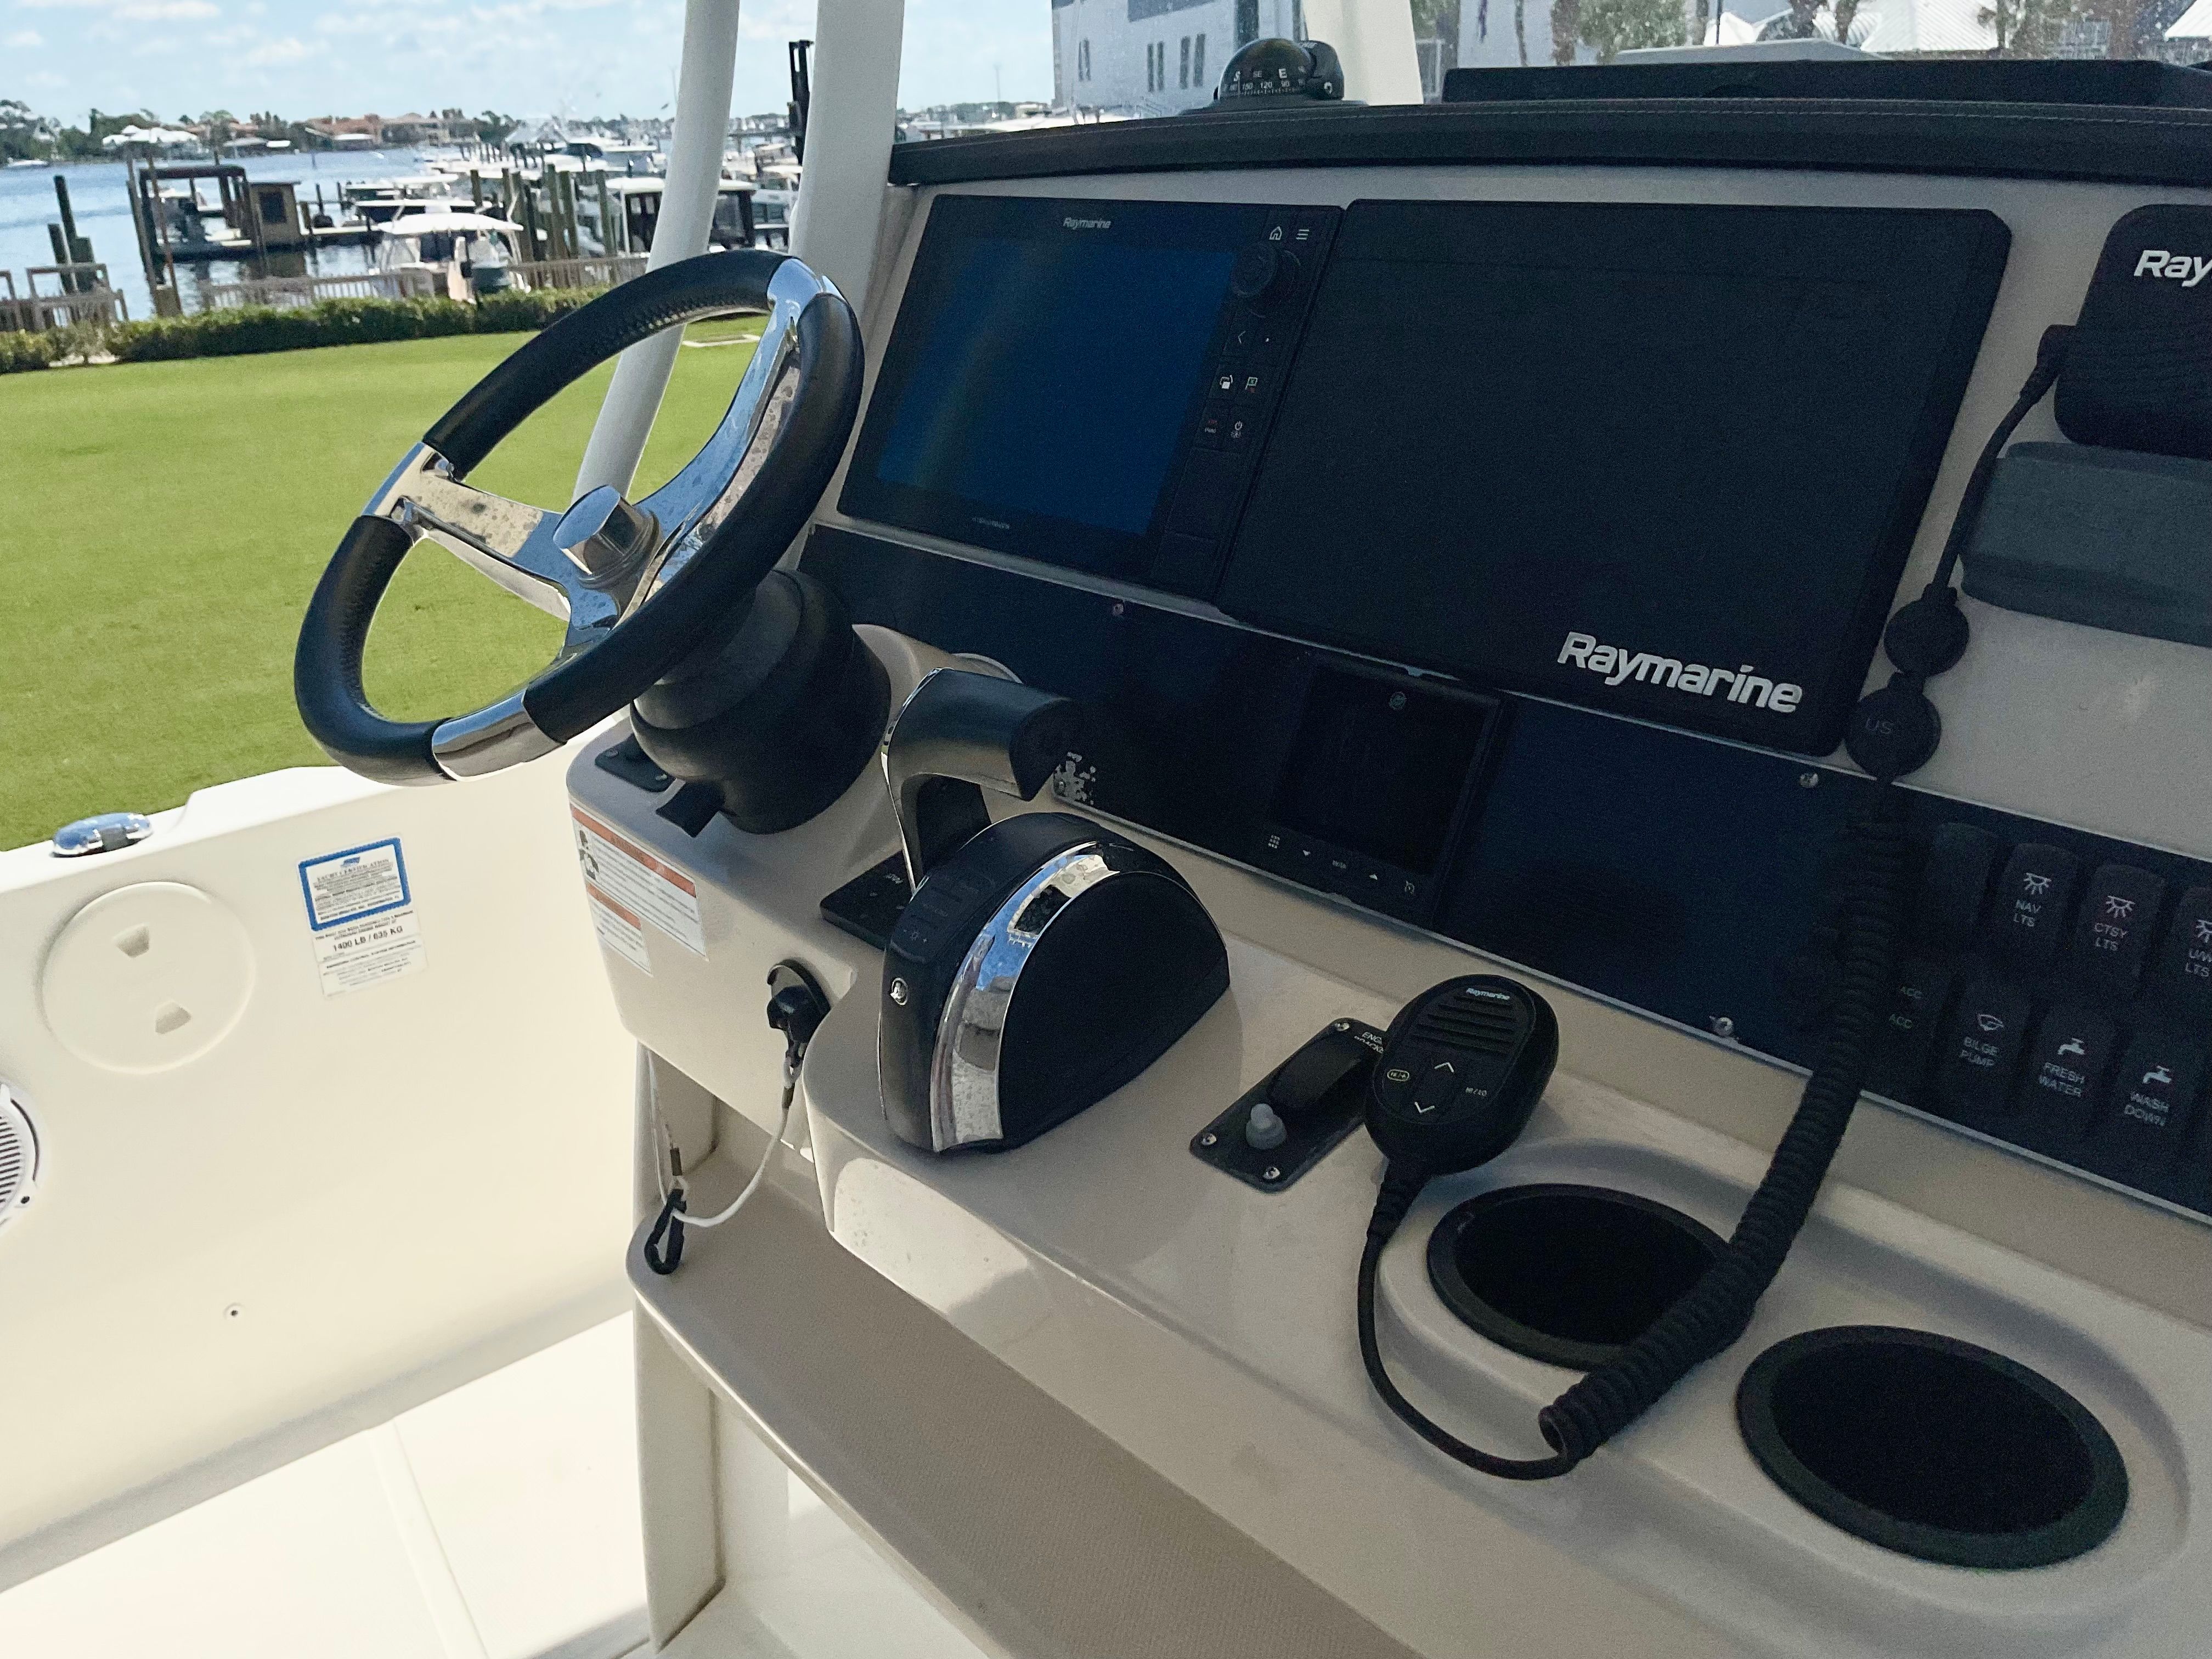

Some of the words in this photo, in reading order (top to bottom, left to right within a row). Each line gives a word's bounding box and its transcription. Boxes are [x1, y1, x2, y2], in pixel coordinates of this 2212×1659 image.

[1278, 68, 1287, 78] E
[1261, 81, 1273, 89] 120
[1063, 217, 1111, 230] Raymarine
[1557, 631, 1803, 713] Raymarine
[2015, 899, 2041, 913] NAV
[2013, 913, 2035, 927] LTS
[2094, 923, 2128, 938] CTSY
[333, 939, 353, 951] 1400
[355, 936, 366, 946] LB
[390, 926, 403, 936] KG
[2096, 937, 2119, 951] LTS
[2185, 962, 2210, 977] LTS
[1466, 988, 1510, 1000] Raymarine
[1889, 1014, 1912, 1029] ACC
[1964, 1036, 1999, 1057] BILGE
[1960, 1049, 1995, 1067] PUMP
[2044, 1062, 2085, 1084] FRESH
[2038, 1075, 2081, 1097] WATER
[2130, 1091, 2170, 1113] WASH
[2124, 1104, 2166, 1127] DOWN
